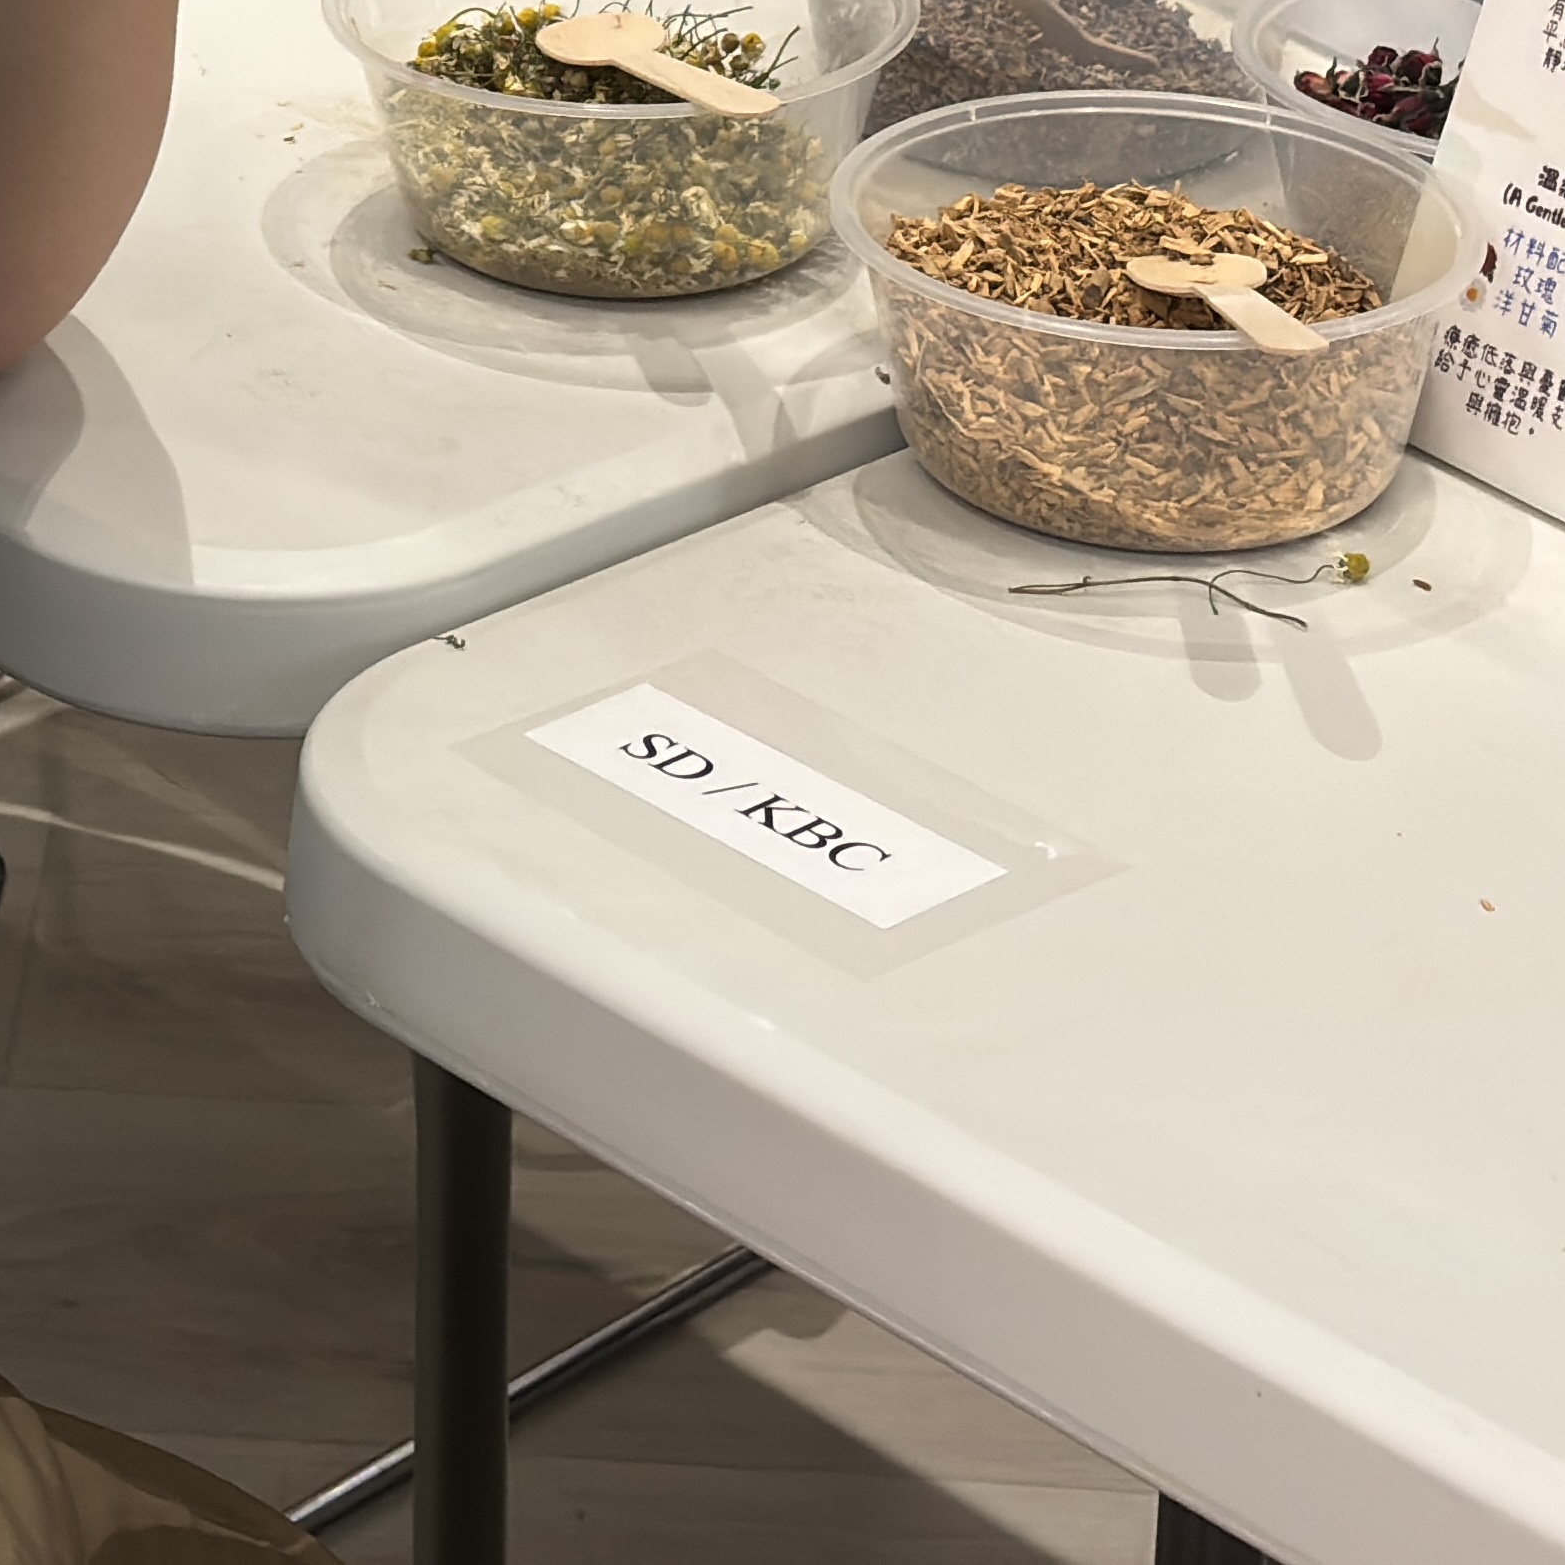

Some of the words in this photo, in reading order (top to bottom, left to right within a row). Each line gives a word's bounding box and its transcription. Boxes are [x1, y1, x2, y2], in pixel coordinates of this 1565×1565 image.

[1502, 182, 1522, 208] (A
[618, 732, 714, 780] SD
[701, 781, 759, 795] /
[734, 793, 892, 872] KBC
